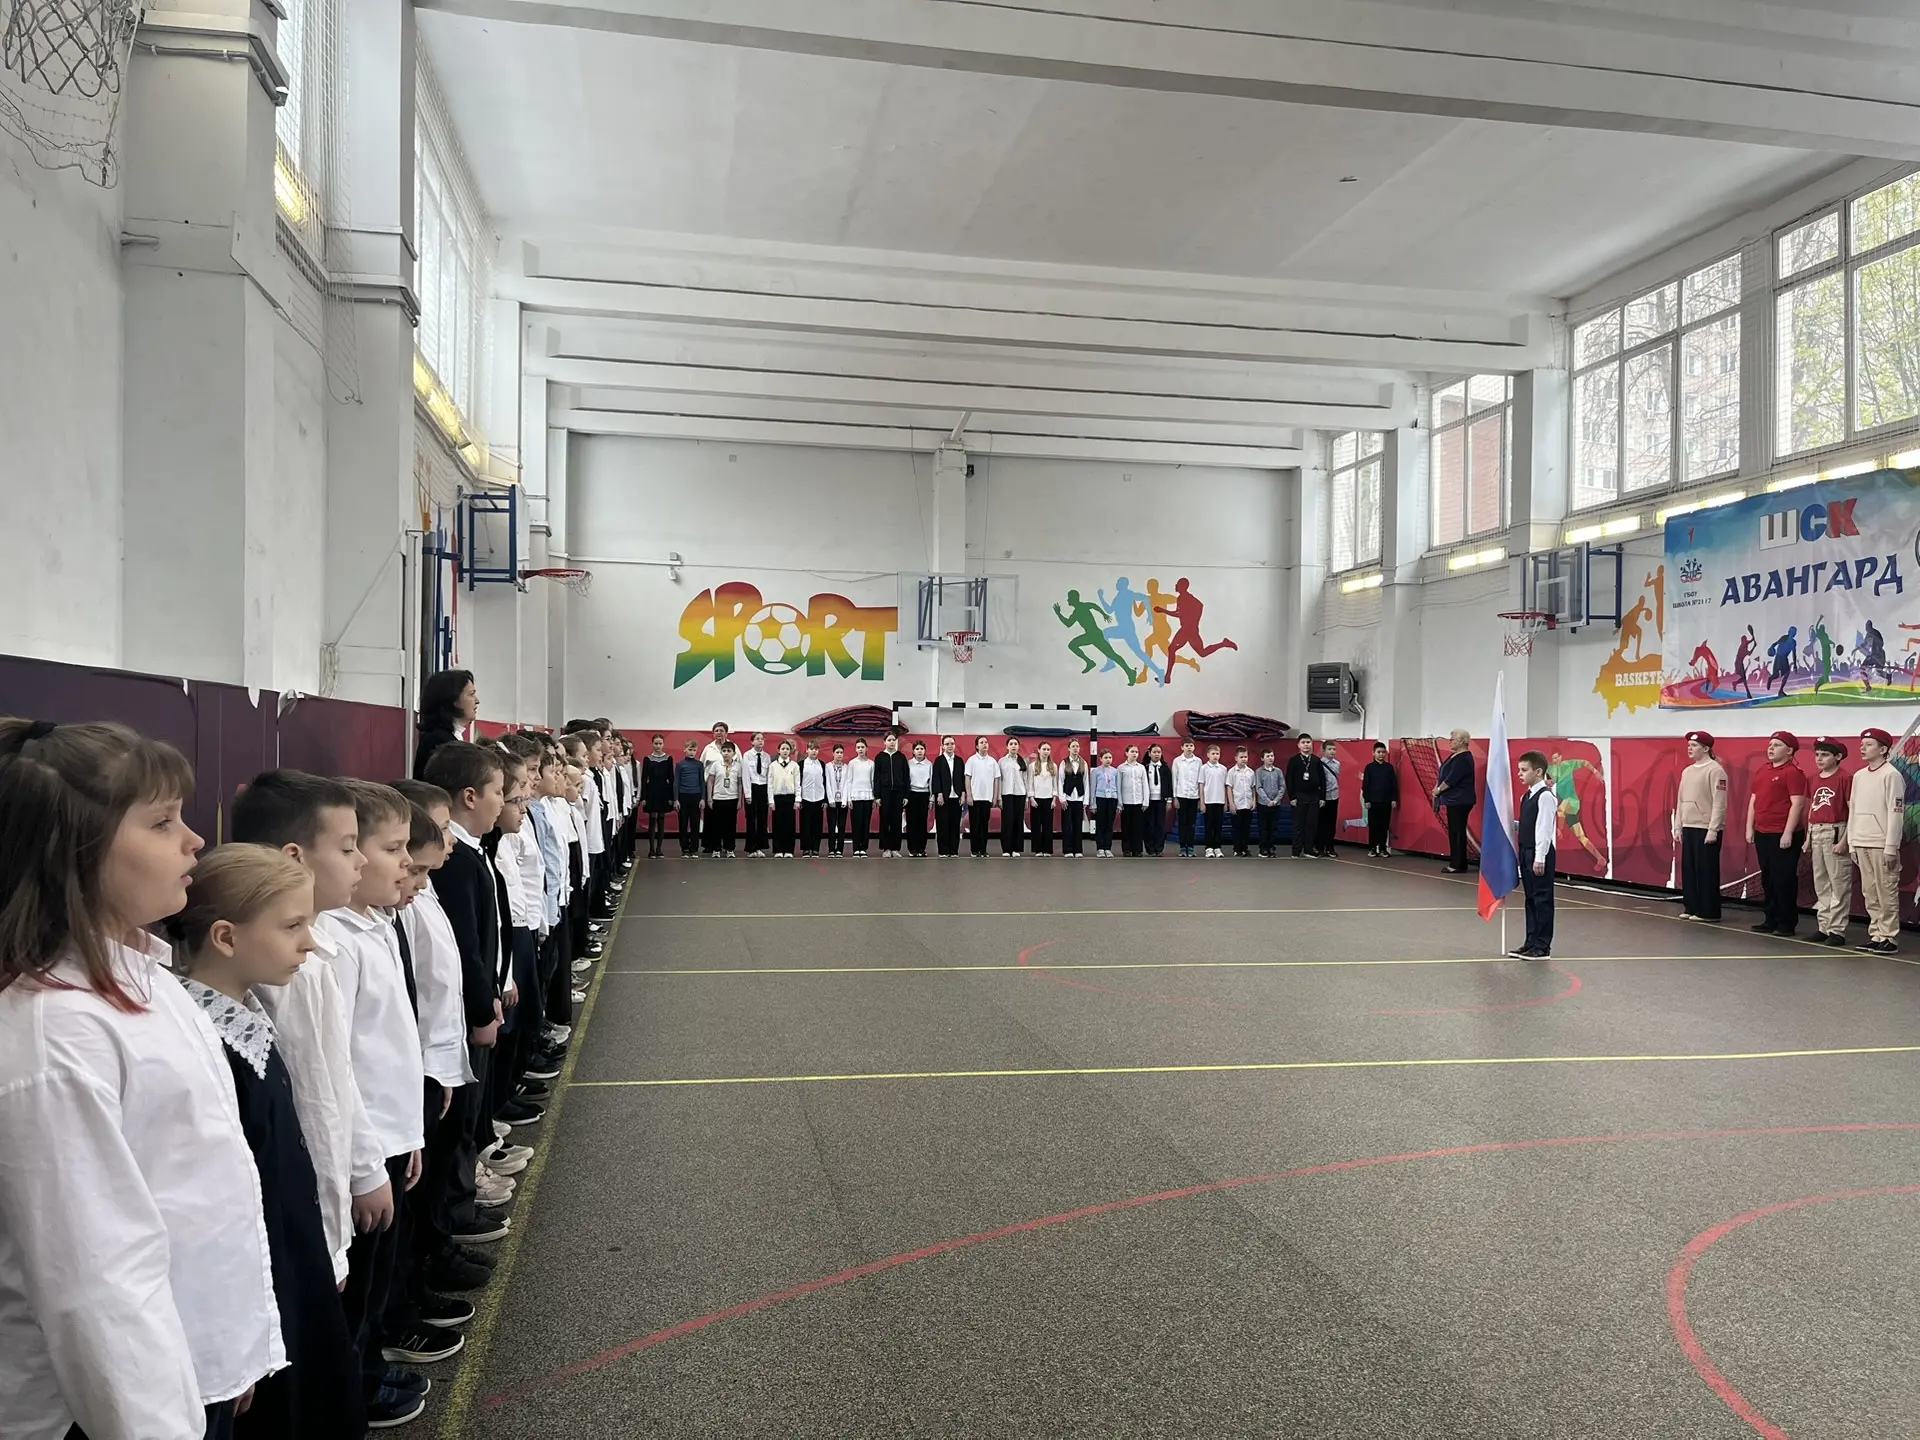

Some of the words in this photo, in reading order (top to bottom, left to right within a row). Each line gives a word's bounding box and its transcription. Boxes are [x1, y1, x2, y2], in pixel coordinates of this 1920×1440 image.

[1759, 498, 1861, 551] ШСК
[1719, 553, 1904, 608] АВАНГАРД
[673, 581, 899, 690] SPORT
